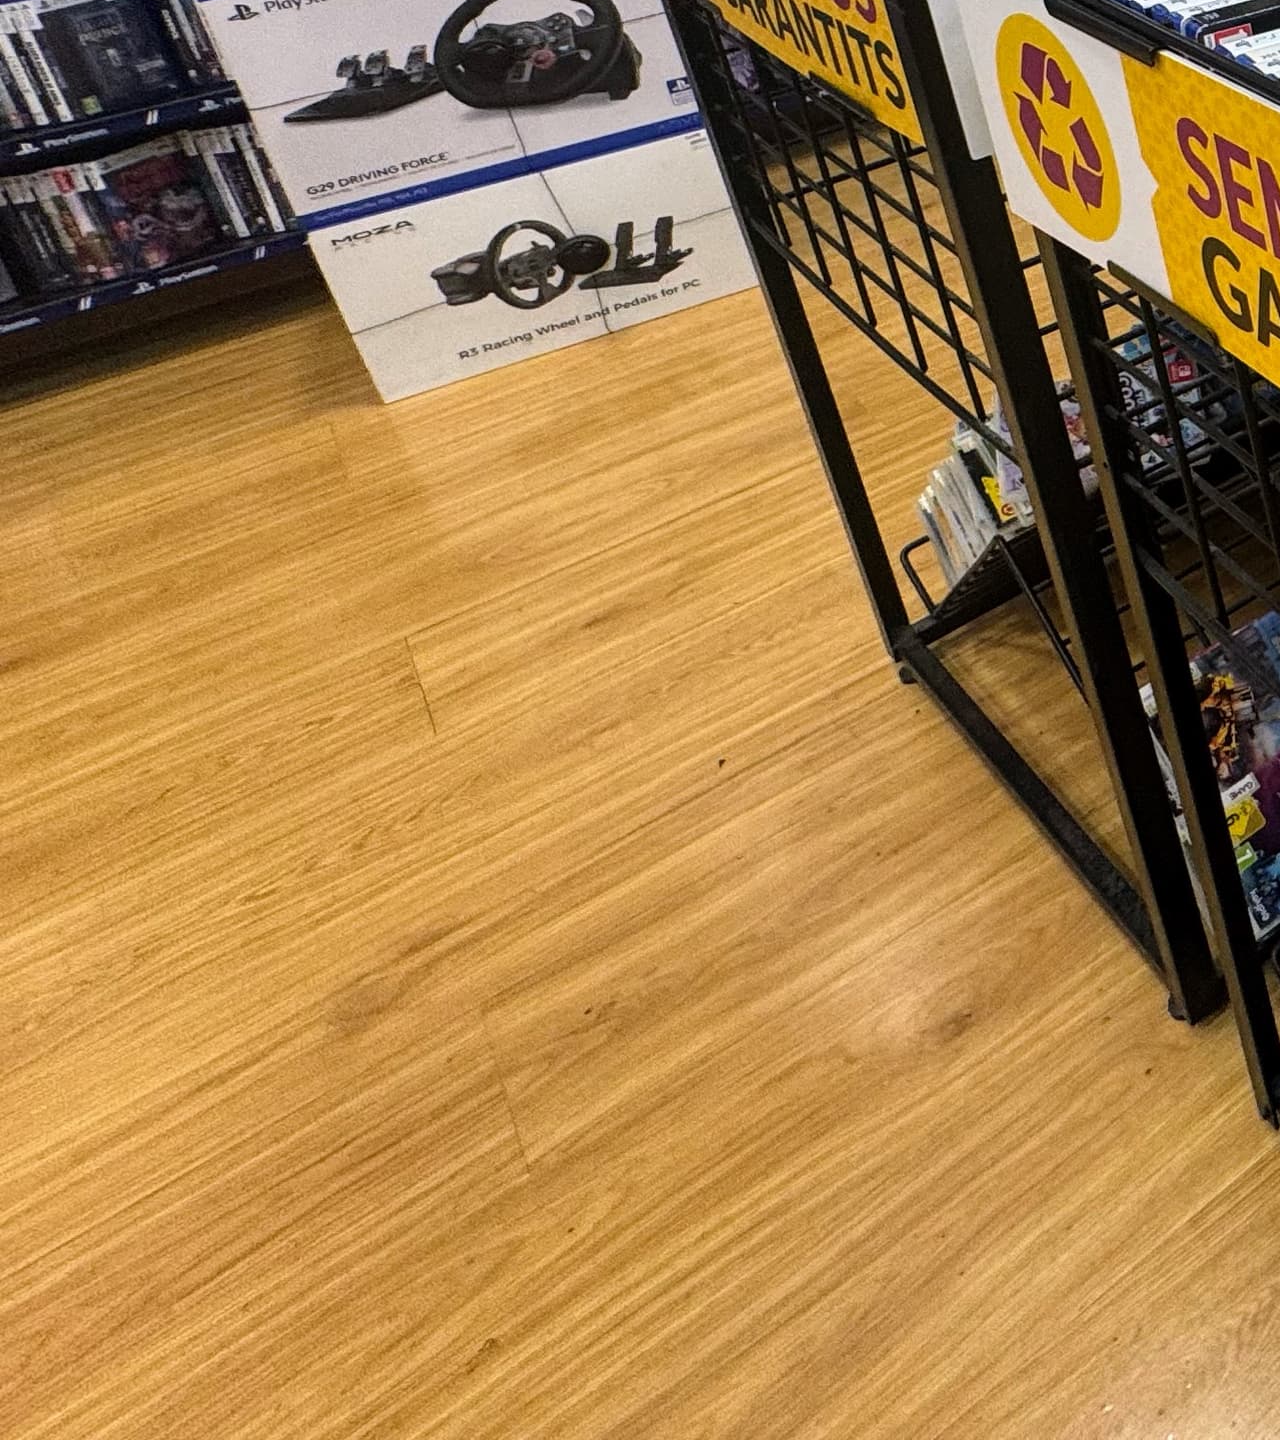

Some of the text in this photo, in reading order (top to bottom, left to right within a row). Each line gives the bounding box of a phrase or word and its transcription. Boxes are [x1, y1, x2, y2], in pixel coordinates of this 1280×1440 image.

[306, 152, 449, 199] G29 DRIVING FORCE
[330, 219, 413, 247] MOZA
[459, 277, 701, 362] R3 Racing Wheel and Pedals for PC
